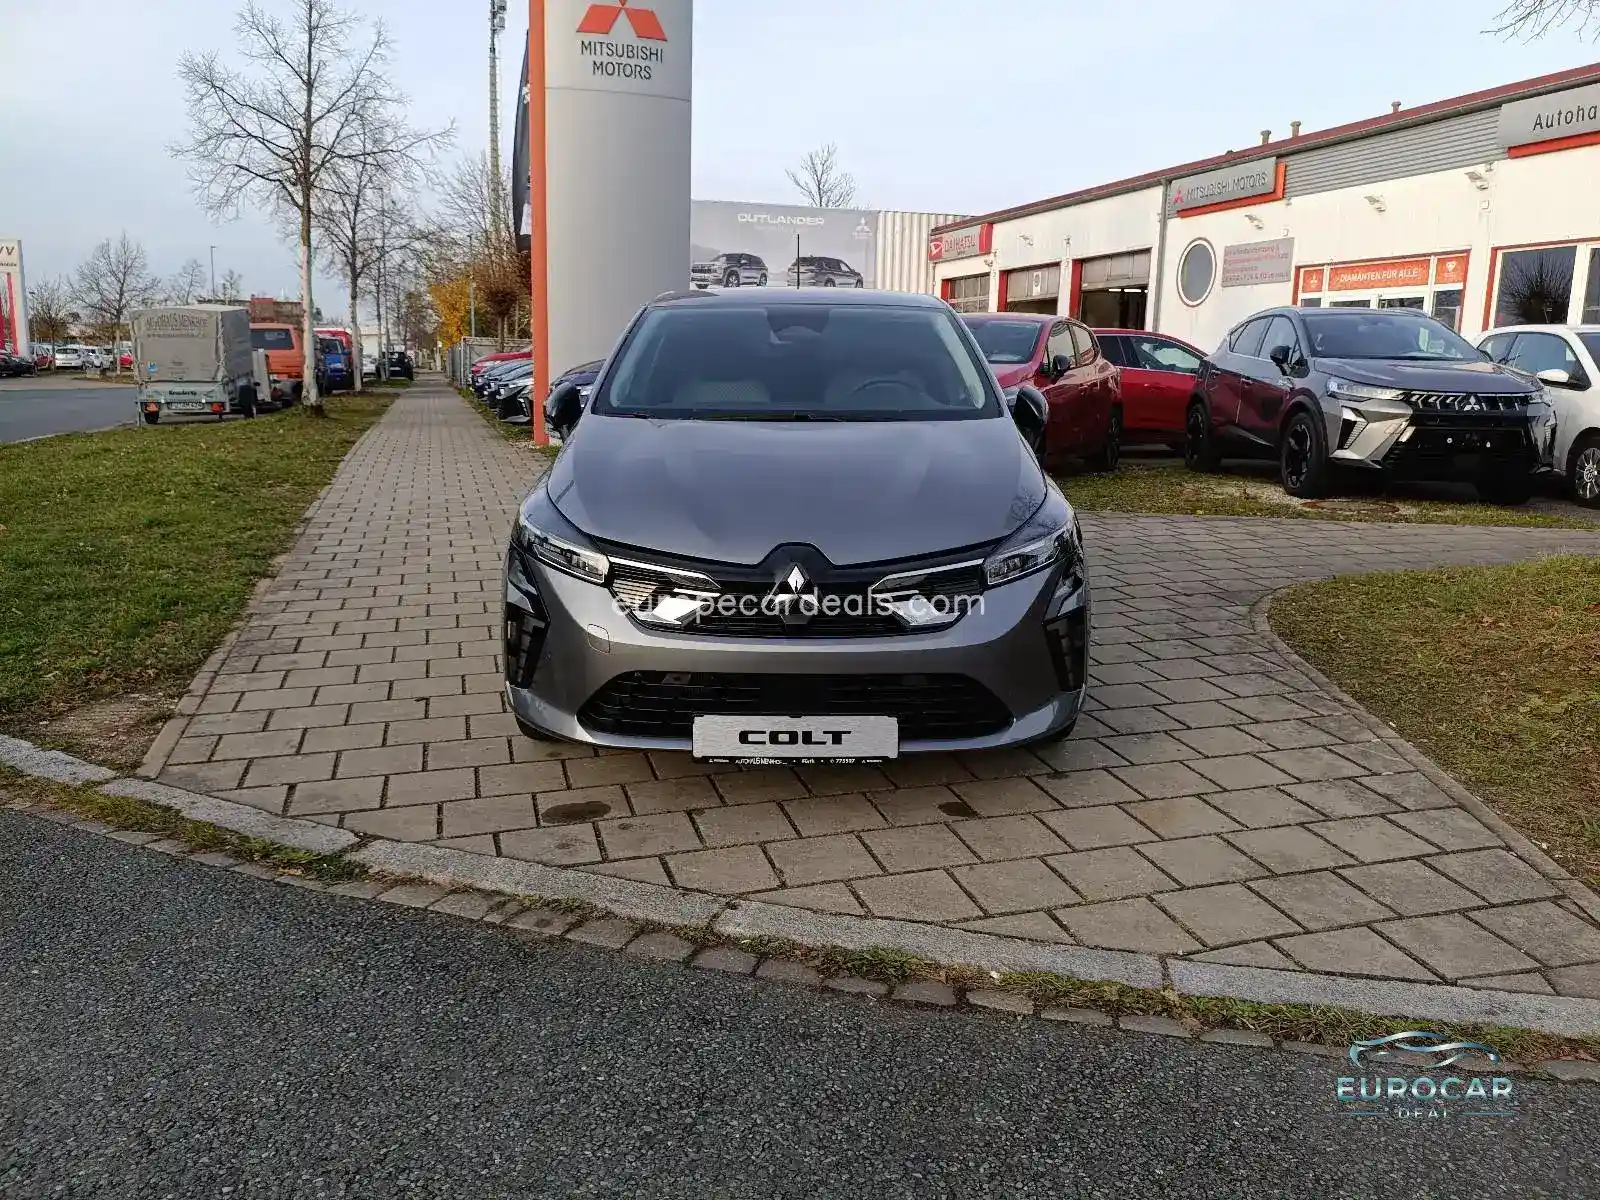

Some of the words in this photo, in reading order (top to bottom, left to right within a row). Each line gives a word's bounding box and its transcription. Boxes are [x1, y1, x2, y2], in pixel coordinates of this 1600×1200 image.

[581, 40, 664, 63] MITSUBISHI
[592, 61, 653, 80] MOTORS
[1532, 105, 1598, 131] Autoha
[1186, 180, 1231, 200] MITSUBISHI
[1233, 171, 1268, 191] MOTORS
[737, 213, 825, 226] OUTLANDER
[1340, 271, 1381, 282] DIAMANTEN
[738, 730, 852, 745] COLT
